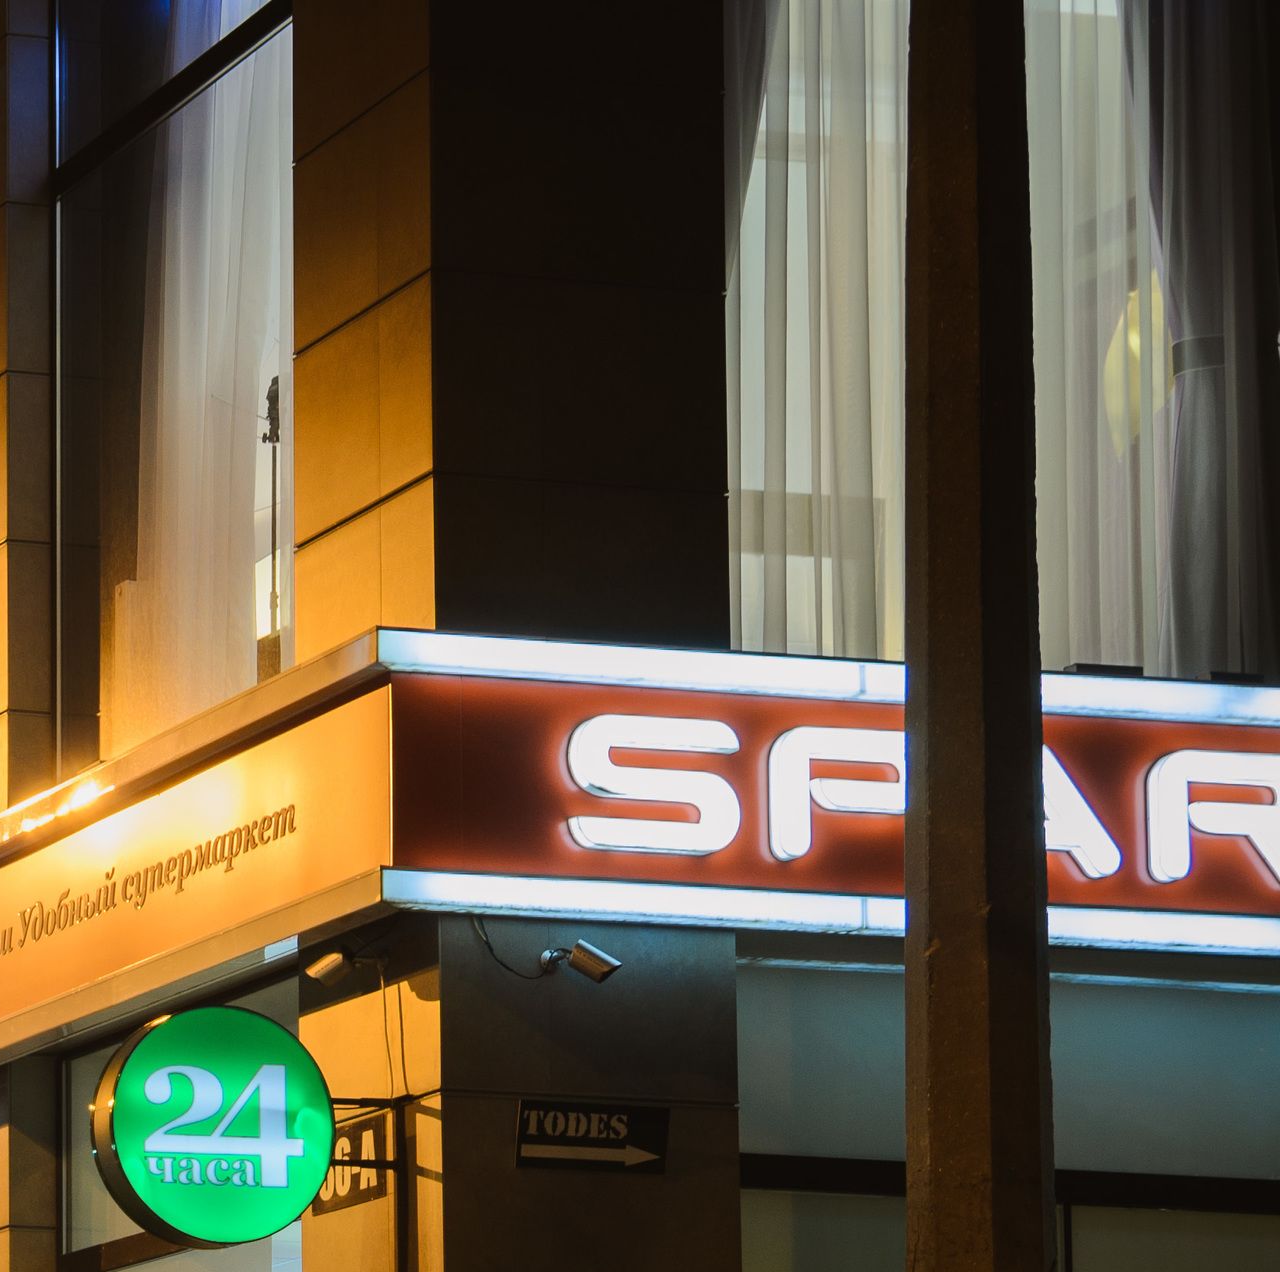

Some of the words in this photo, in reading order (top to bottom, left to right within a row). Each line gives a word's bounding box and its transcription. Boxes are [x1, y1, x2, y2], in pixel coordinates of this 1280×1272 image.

[17, 867, 118, 947] Удобный
[121, 803, 297, 911] супермаркет
[143, 1063, 304, 1189] 24
[523, 1109, 628, 1140] TODES
[145, 1155, 258, 1188] часа
